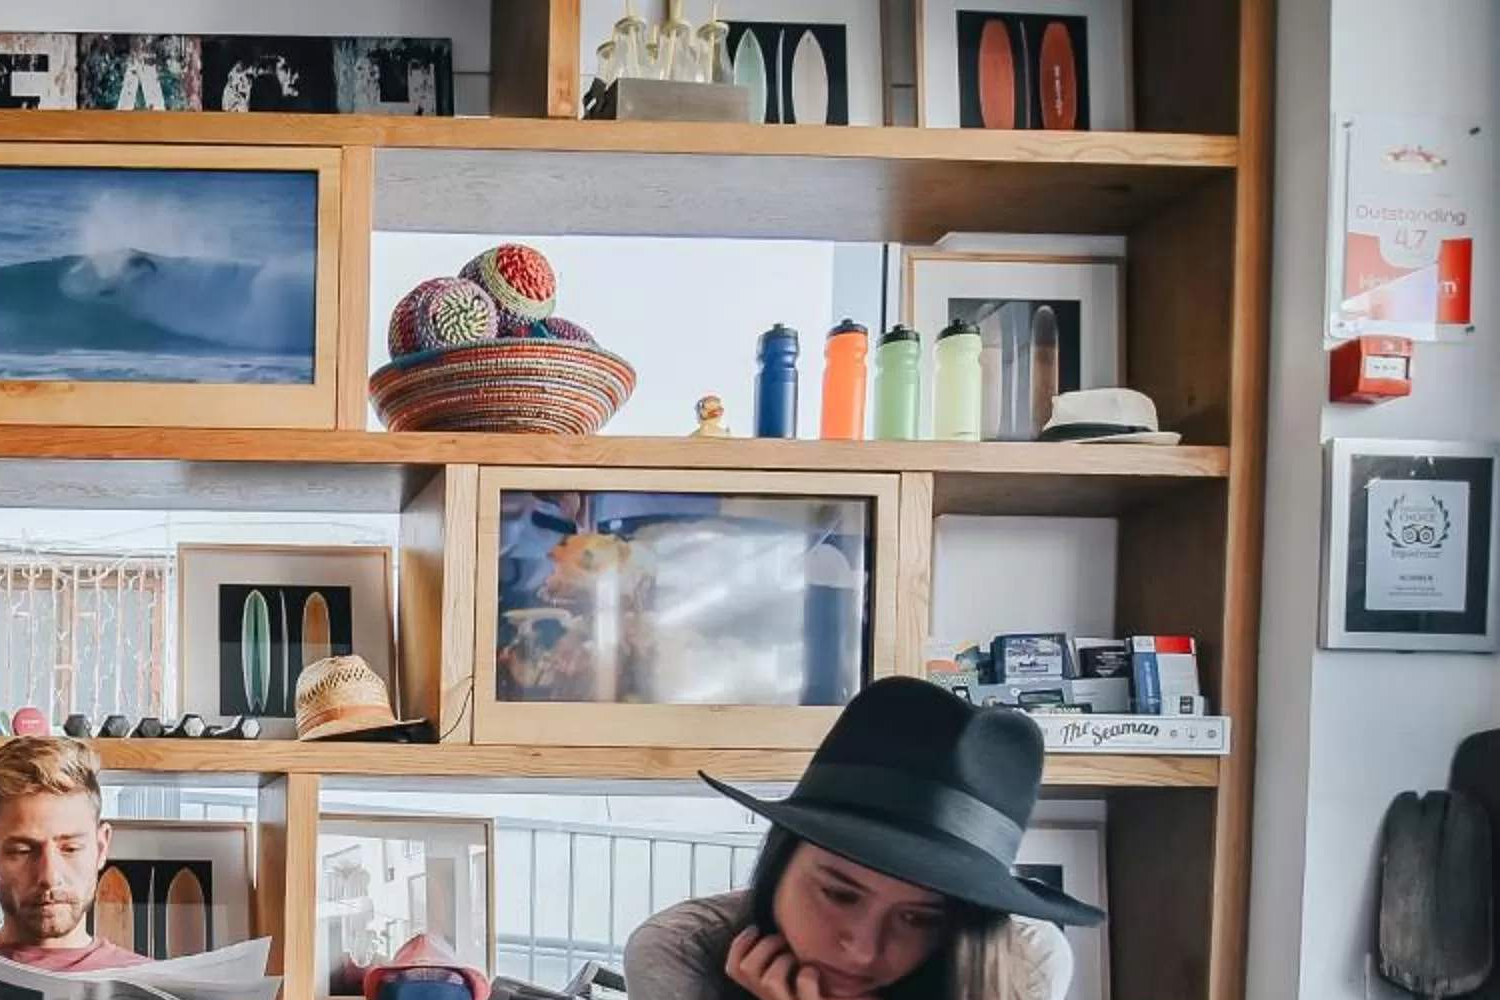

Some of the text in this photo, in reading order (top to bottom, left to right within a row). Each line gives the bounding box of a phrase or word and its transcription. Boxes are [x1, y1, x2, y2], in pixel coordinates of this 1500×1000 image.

[1356, 205, 1467, 226] Outstanding
[1060, 721, 1160, 746] The Seaman
